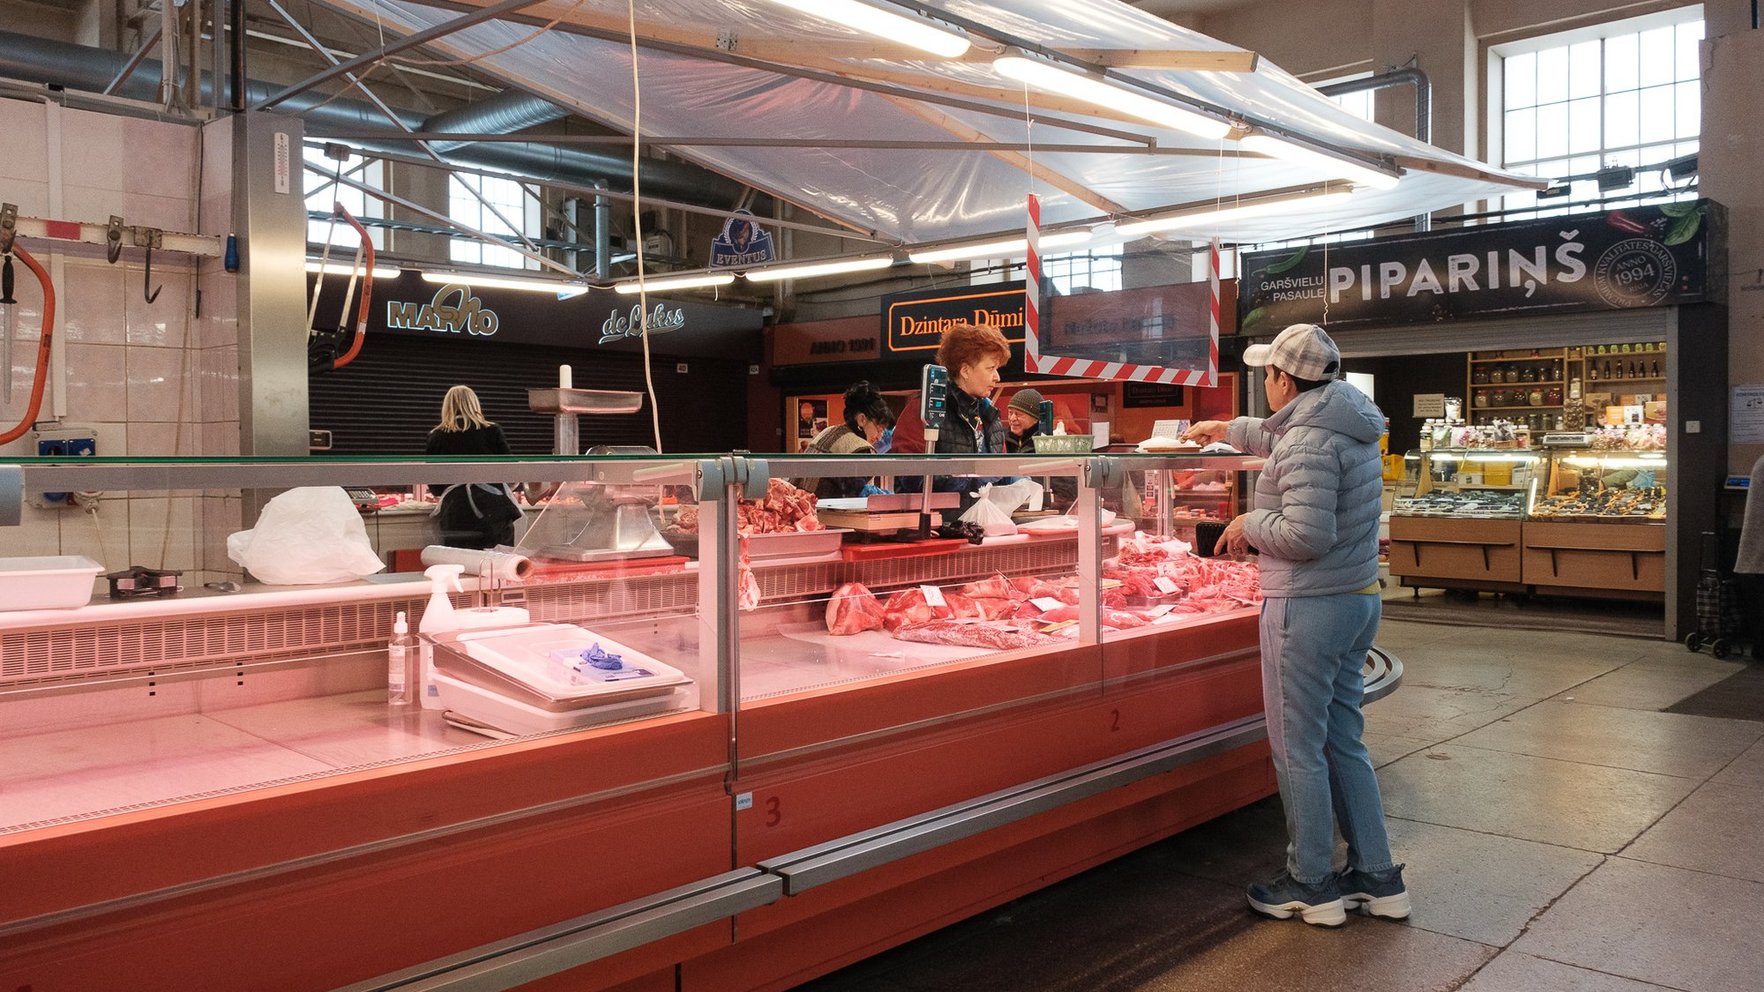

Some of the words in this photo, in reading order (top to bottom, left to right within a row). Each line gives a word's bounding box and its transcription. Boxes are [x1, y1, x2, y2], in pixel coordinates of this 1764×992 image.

[716, 249, 767, 265] EVENTUS
[1329, 229, 1587, 298] PIPARIŅŠ
[1616, 255, 1647, 271] ANNO
[1260, 275, 1324, 291] GARŠVIELU
[1615, 263, 1655, 286] 1994
[1273, 288, 1325, 302] PASAULE
[974, 307, 1024, 329] Dūmi
[1111, 709, 1120, 732] 2
[765, 796, 781, 827] 3
